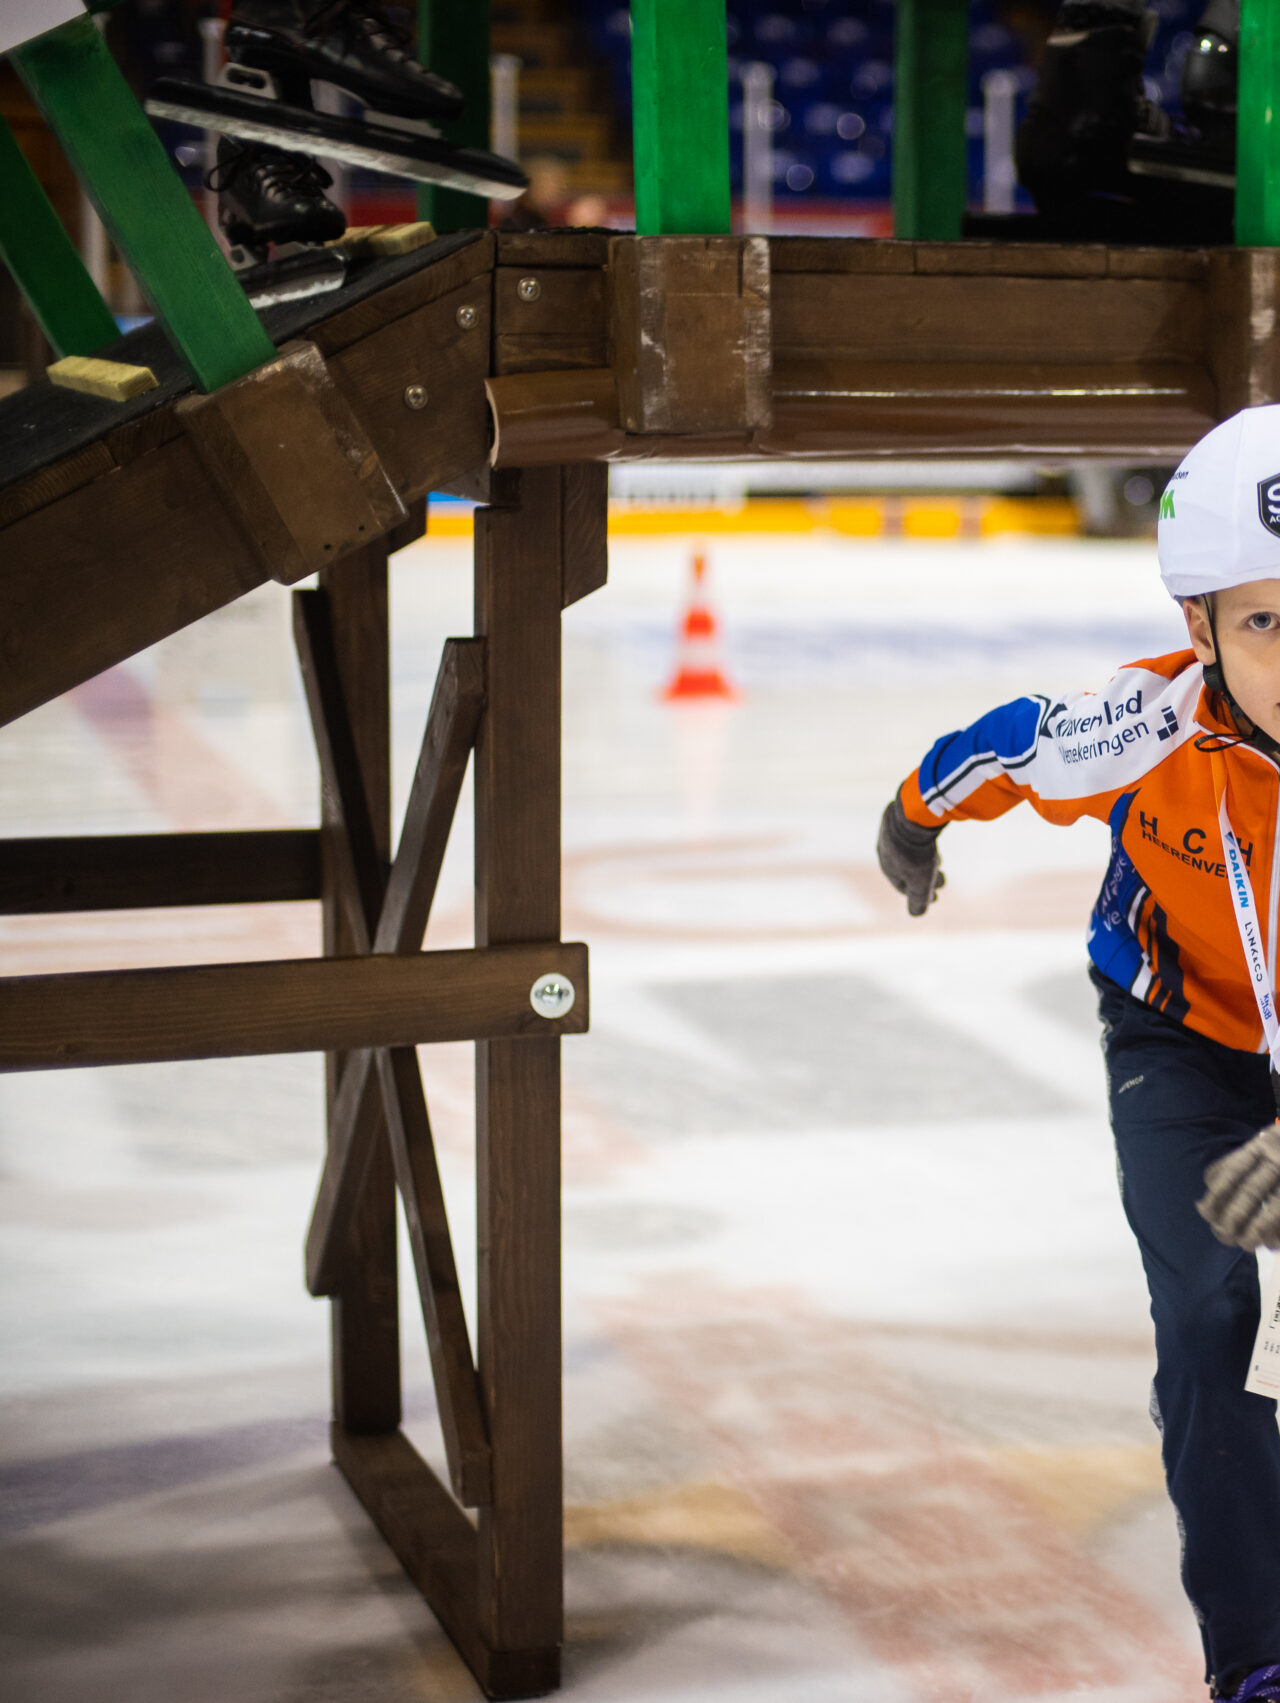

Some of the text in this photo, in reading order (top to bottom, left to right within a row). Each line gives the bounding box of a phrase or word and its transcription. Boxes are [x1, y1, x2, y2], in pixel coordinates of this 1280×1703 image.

[1139, 811, 1158, 836] H
[1182, 828, 1207, 855] C
[1142, 828, 1250, 880] HEERENVE
[1229, 849, 1250, 908] DAIKIN
